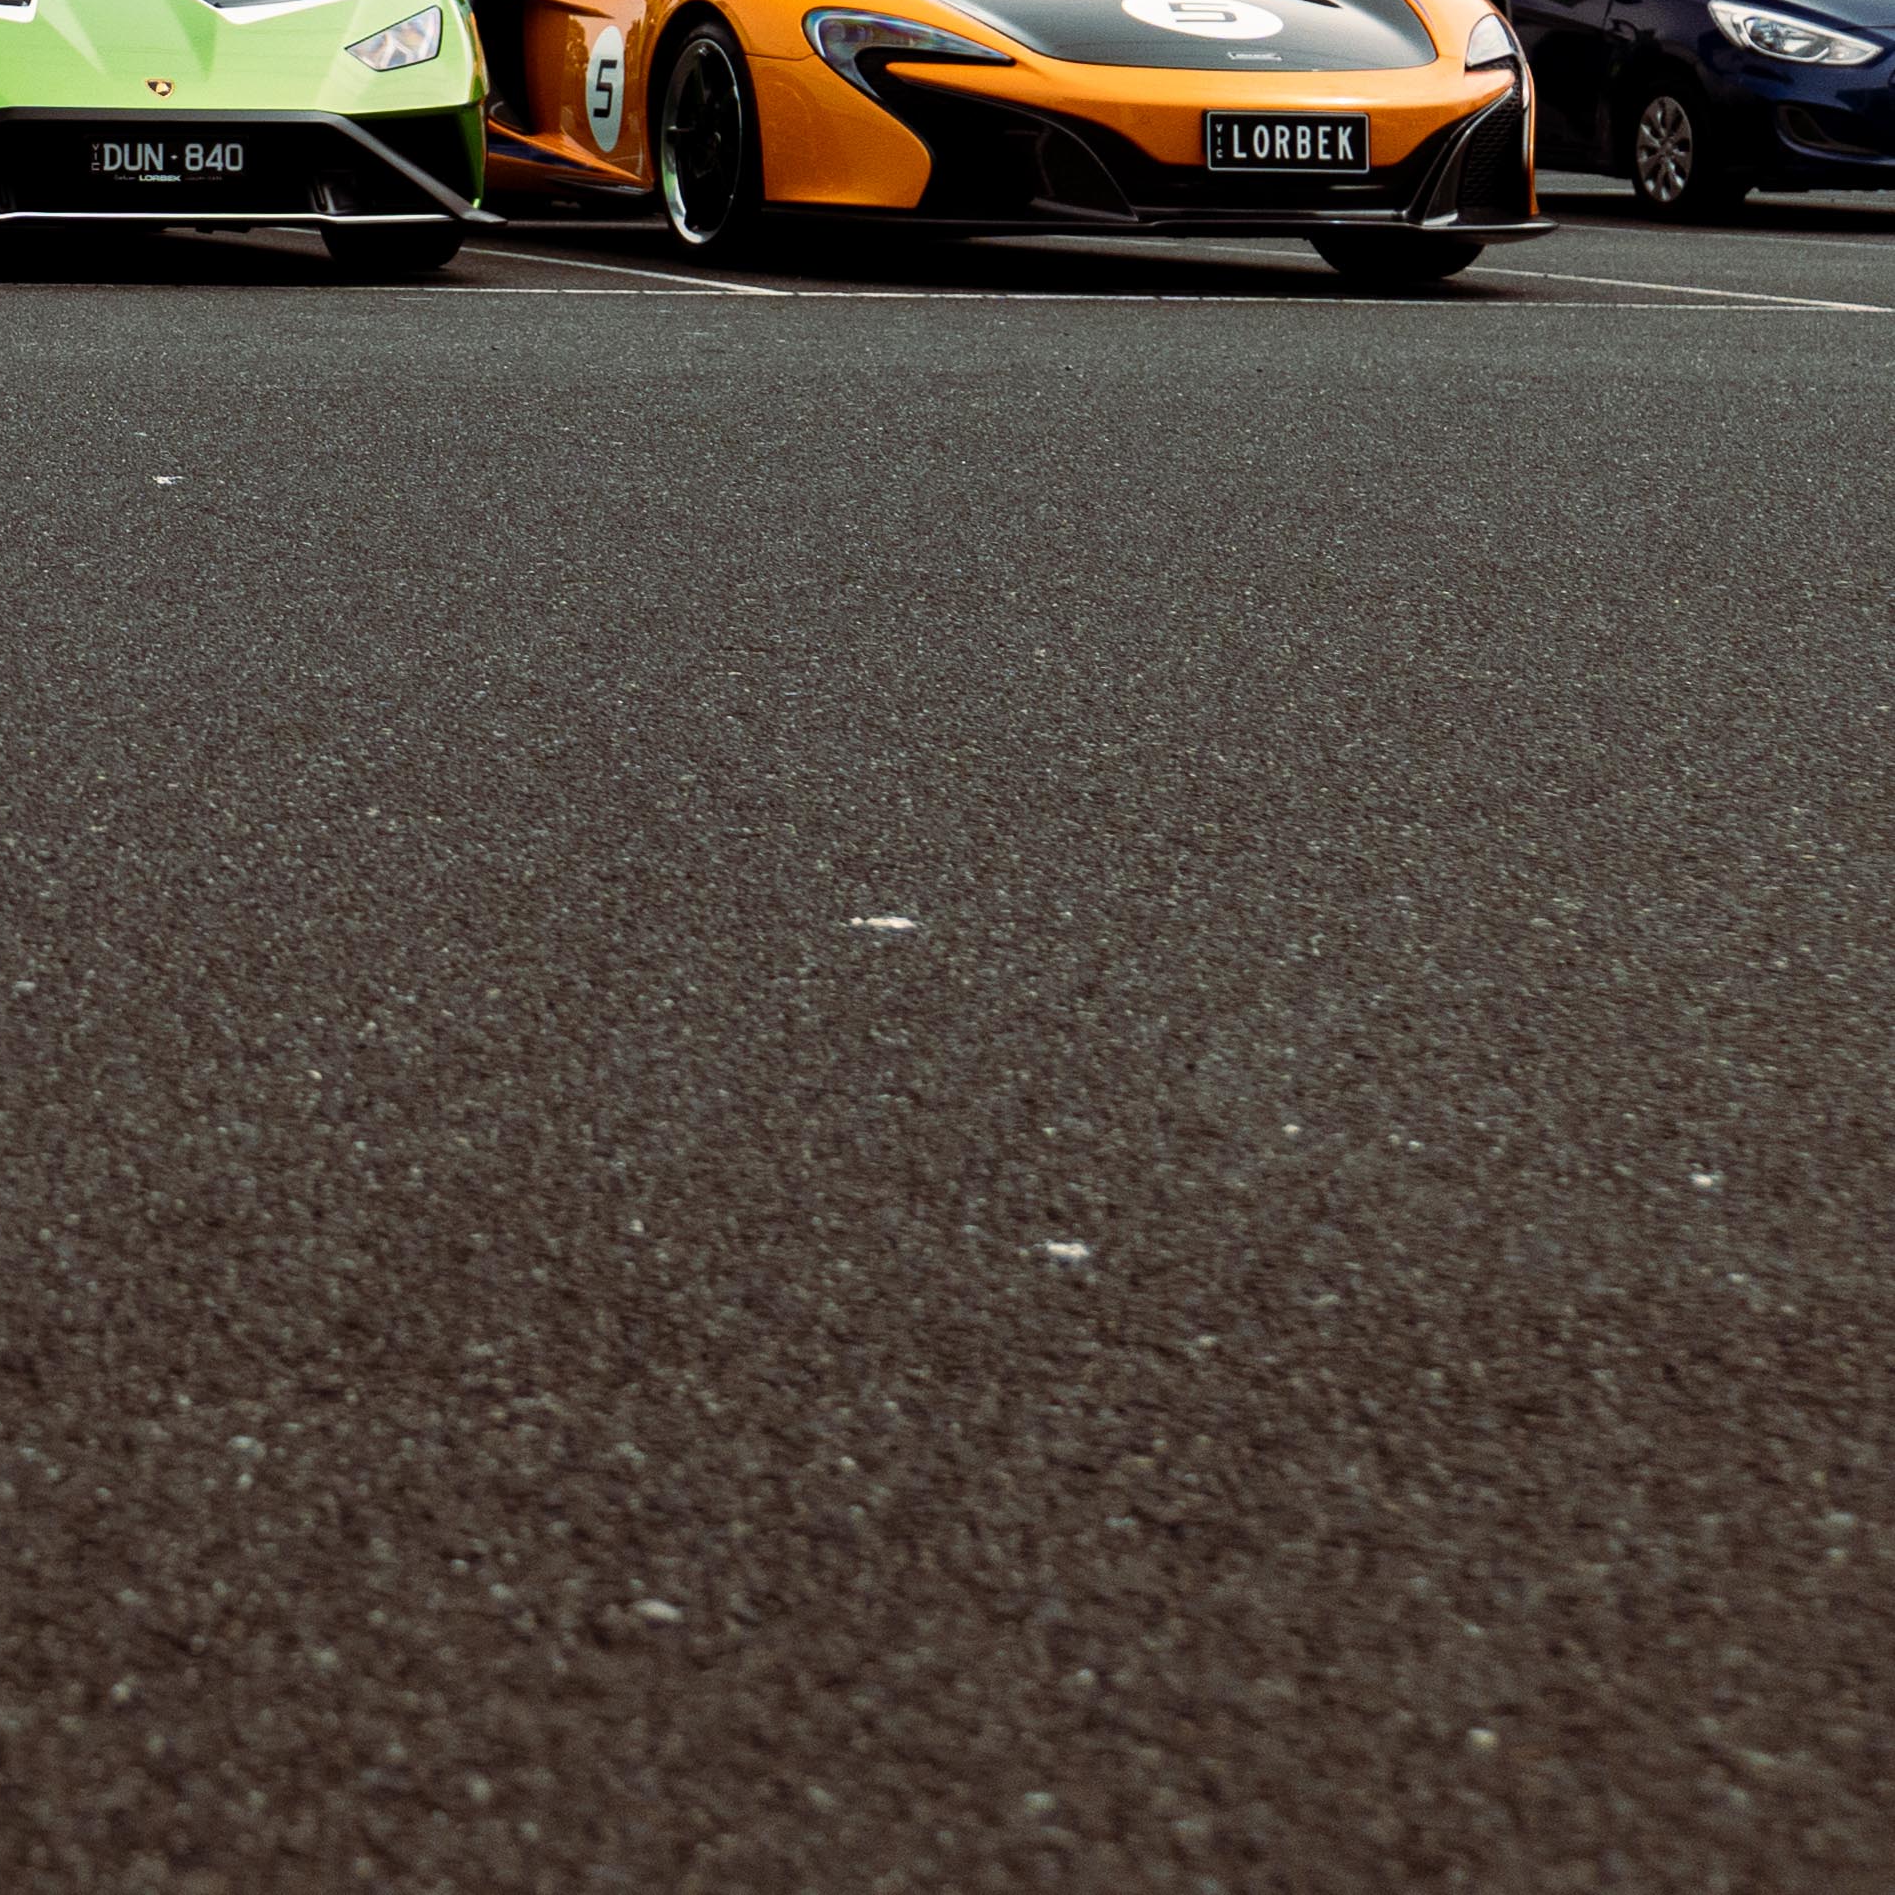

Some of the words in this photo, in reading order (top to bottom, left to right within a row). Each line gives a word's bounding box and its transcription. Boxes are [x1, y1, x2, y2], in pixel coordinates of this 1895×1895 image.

[1168, 2, 1237, 23] 5
[593, 59, 618, 118] 5
[1215, 123, 1223, 158] VIC
[1233, 123, 1354, 160] LORBEK
[138, 174, 181, 182] LORBEK
